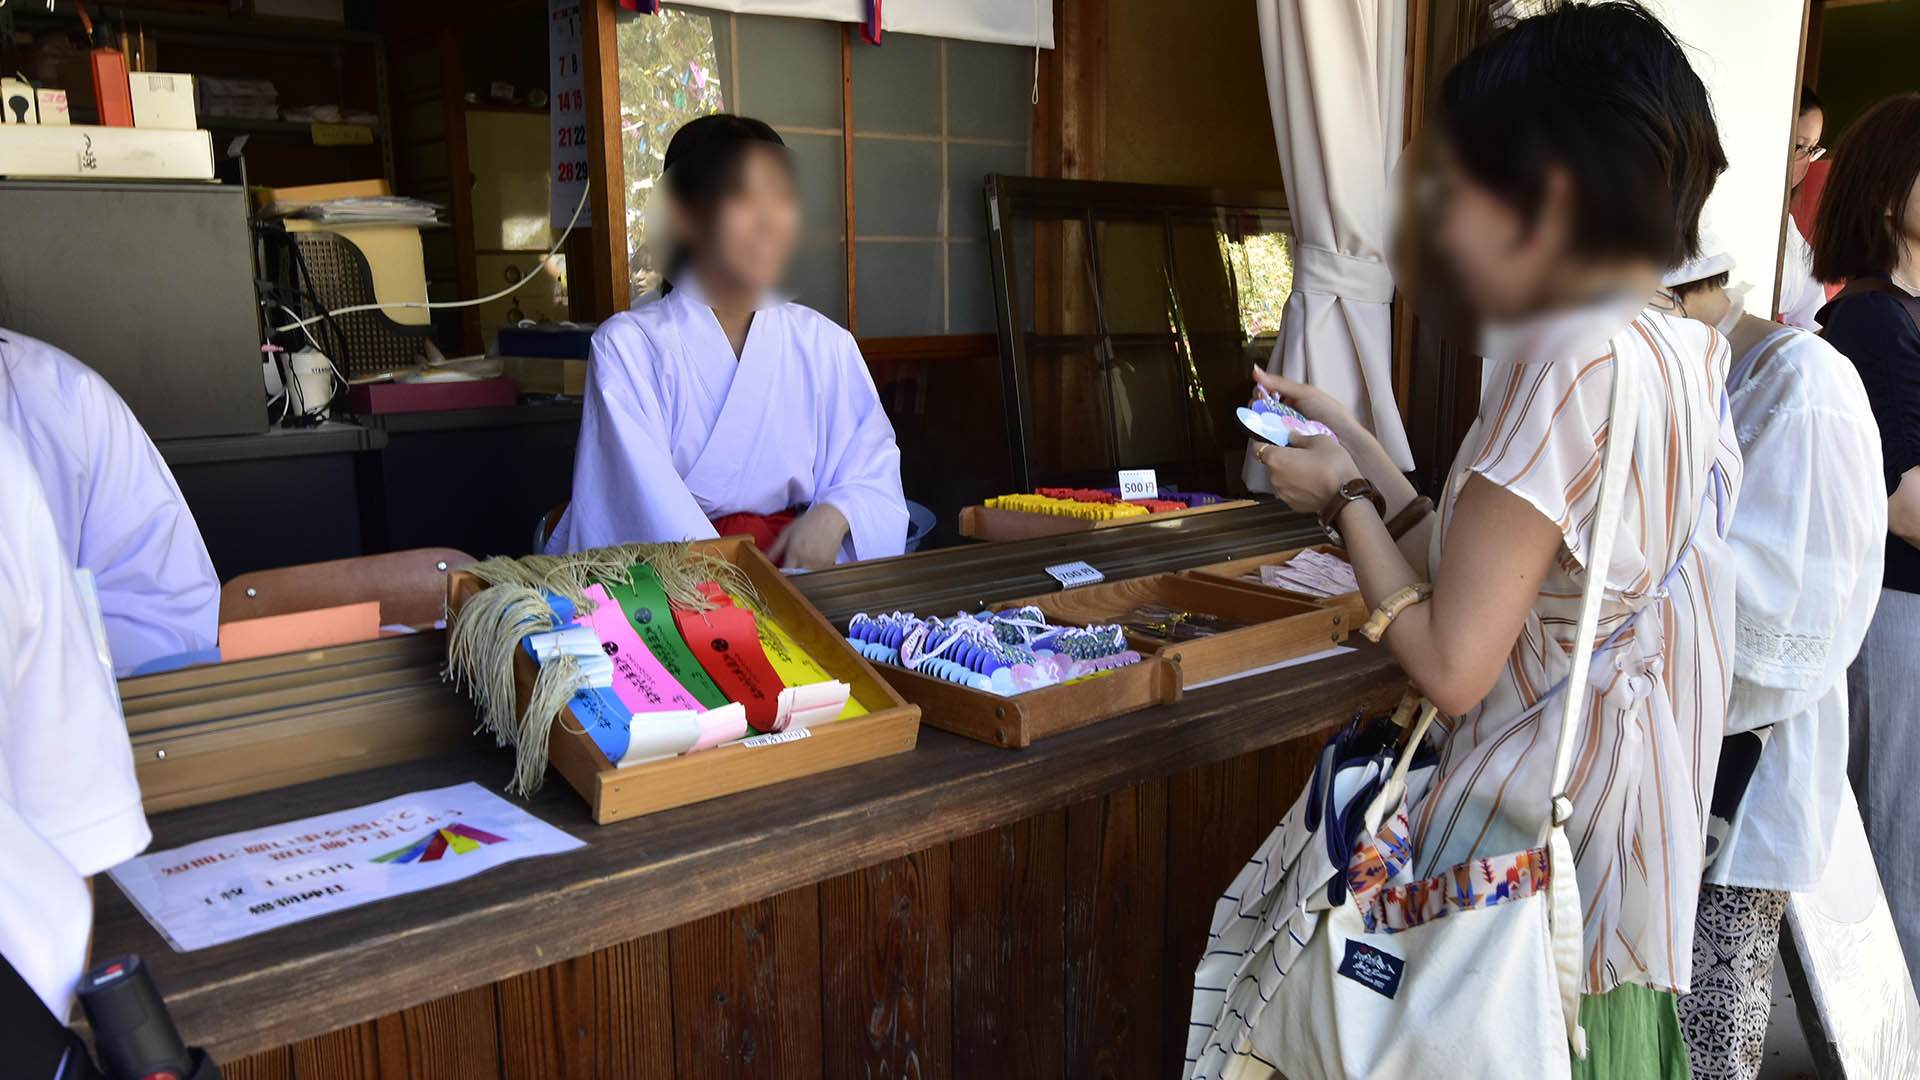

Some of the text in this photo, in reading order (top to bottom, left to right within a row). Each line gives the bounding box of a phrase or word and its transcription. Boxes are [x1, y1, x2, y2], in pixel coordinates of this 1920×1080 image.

[560, 53, 578, 76] 7 8
[557, 88, 583, 112] 14 15
[559, 125, 586, 147] 21 22
[558, 160, 588, 183] 28 29
